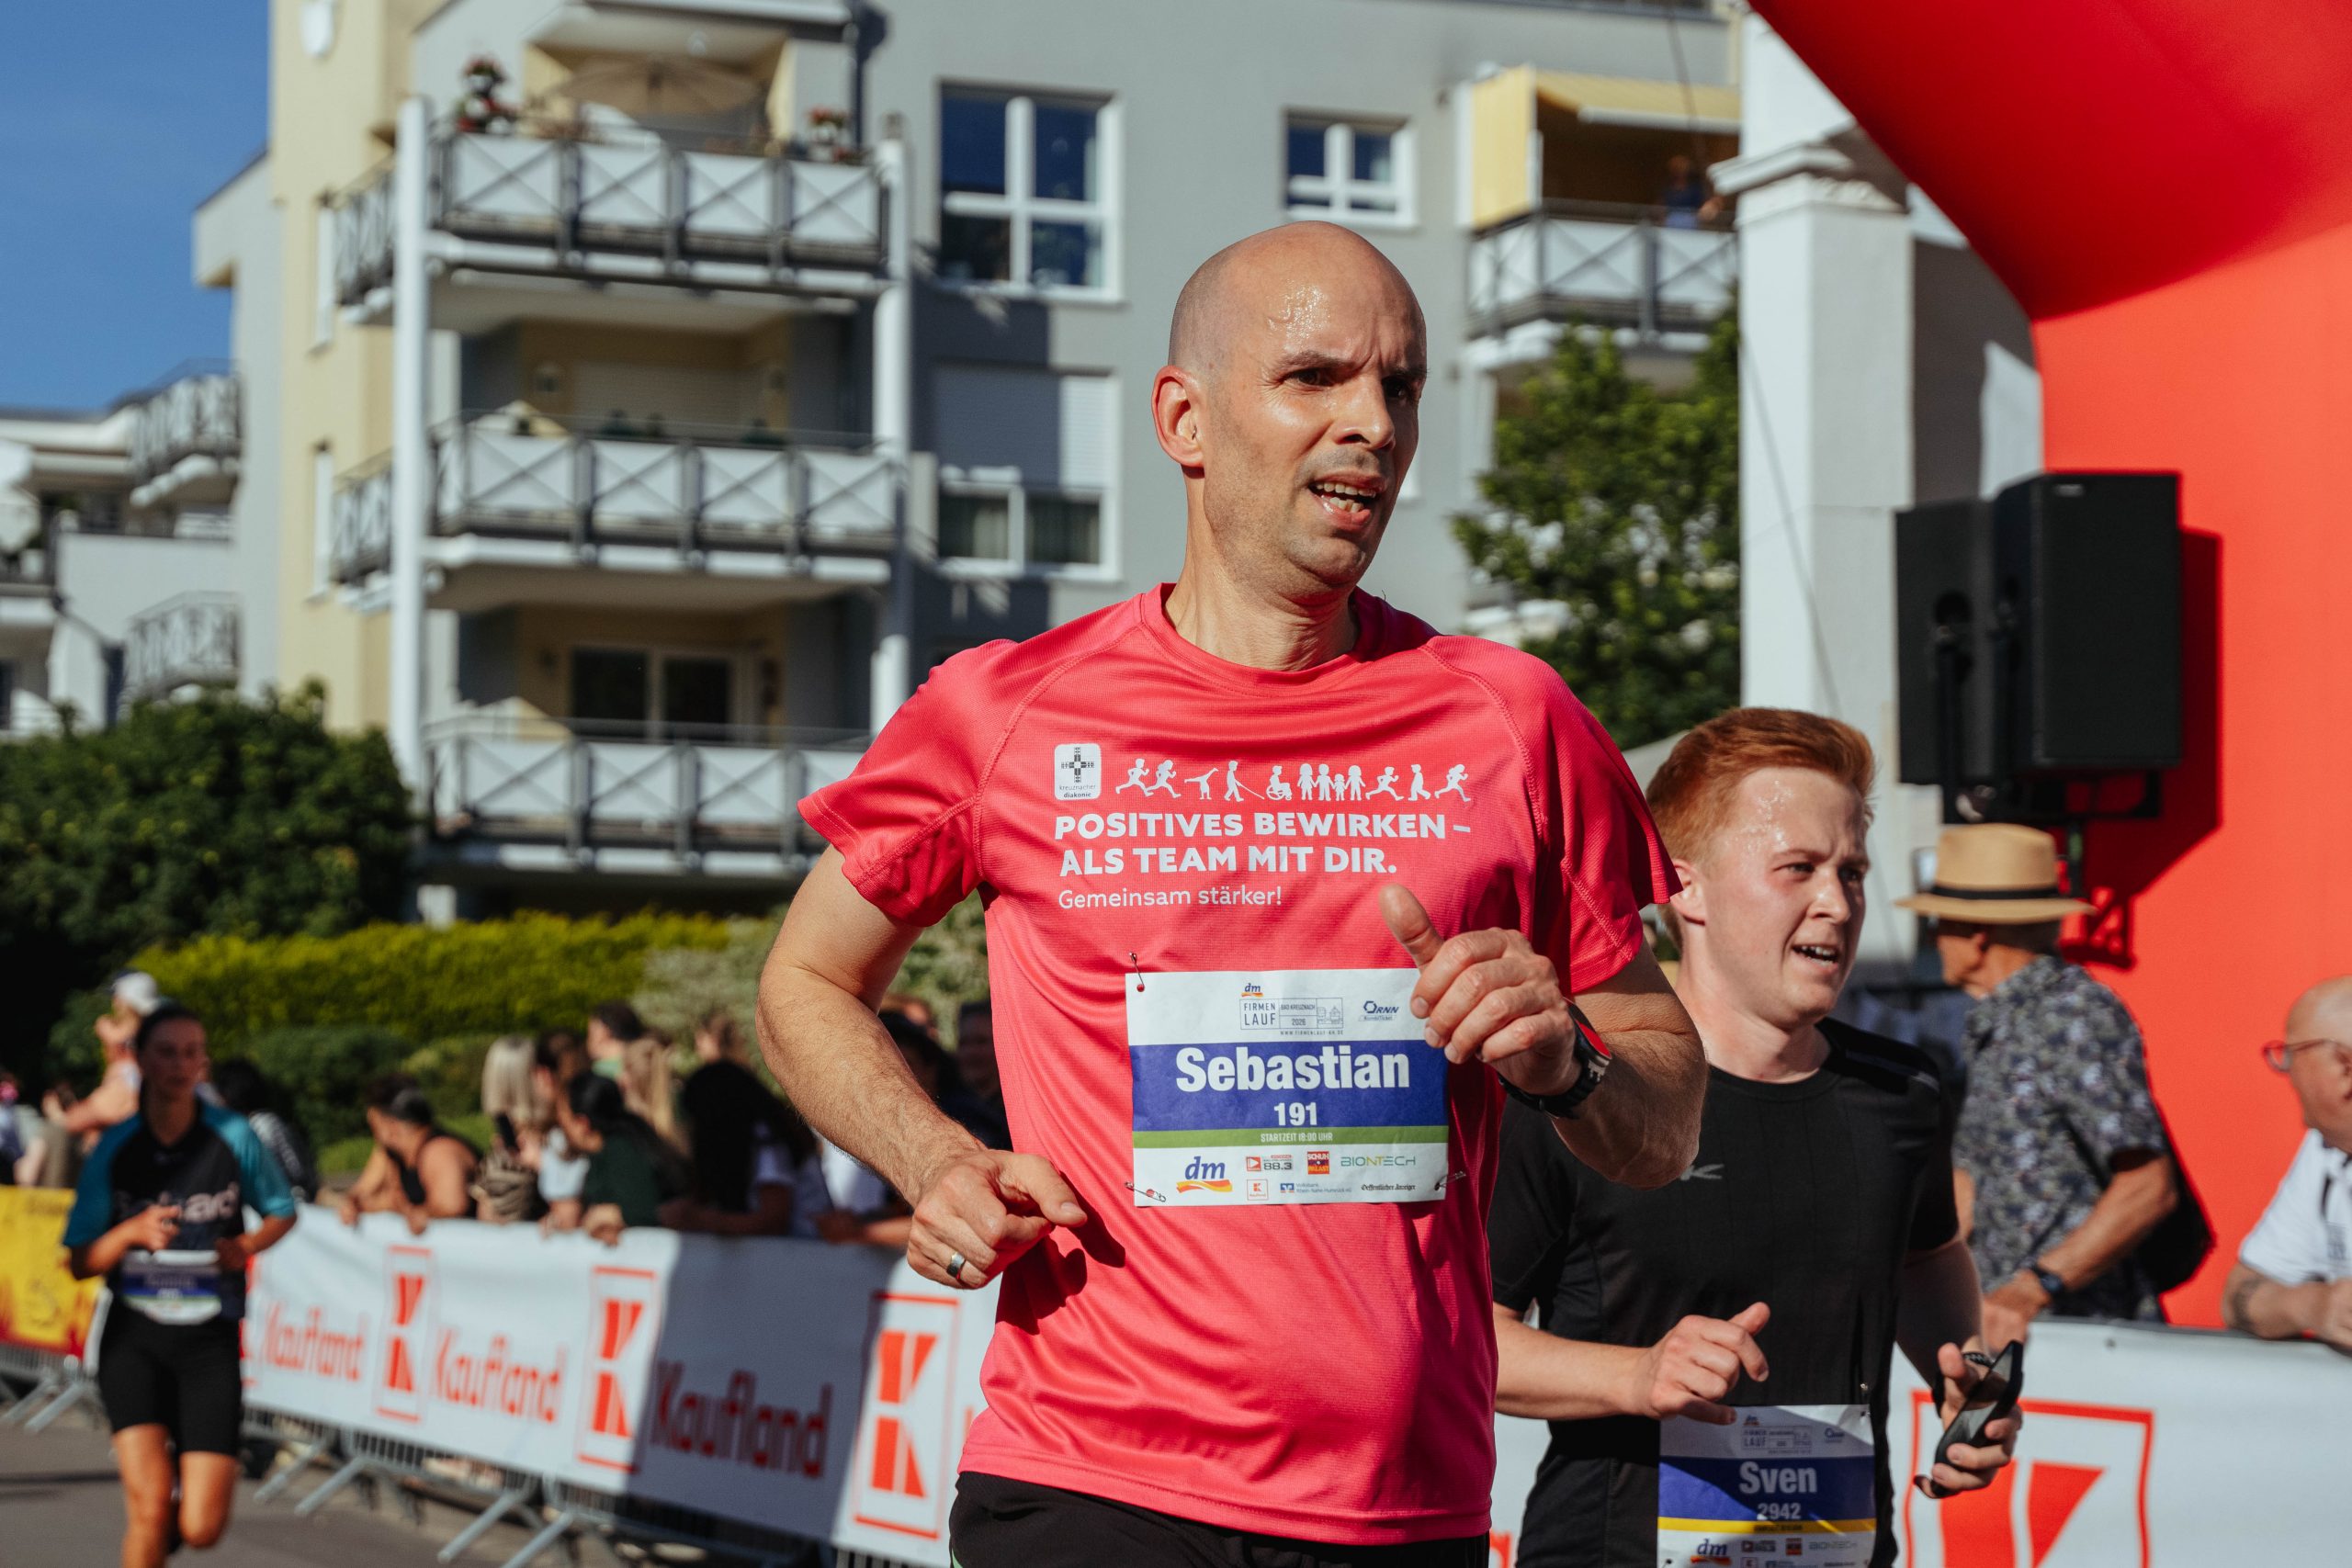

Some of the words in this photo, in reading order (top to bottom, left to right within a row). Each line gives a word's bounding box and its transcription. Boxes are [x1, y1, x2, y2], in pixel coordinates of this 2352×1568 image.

[1055, 812, 1244, 840] POSITIVES
[1254, 812, 1446, 840] BEWIRKEN
[1060, 847, 1125, 877] ALS
[1133, 846, 1237, 874] TEAM
[1248, 846, 1313, 874] MIT
[1324, 846, 1397, 874] DIR.
[1058, 888, 1193, 909] Gemeinsam
[1198, 886, 1282, 907] stärker!
[1244, 983, 1261, 993] dm
[1244, 1002, 1275, 1010] FIRMEN
[1244, 1012, 1275, 1026] LAUF
[1176, 1045, 1409, 1092] Sebastian
[1274, 1102, 1317, 1126] 191
[1261, 1133, 1296, 1143] STARTZEIT
[1318, 1132, 1333, 1141] UHR
[1184, 1156, 1226, 1180] dm
[1263, 1162, 1292, 1170] 88.3
[1340, 1156, 1416, 1167] BIONTECH
[433, 1328, 568, 1424] Kaufland
[648, 1359, 832, 1480] Kaufland
[1739, 1461, 1817, 1494] Sven
[1757, 1502, 1801, 1520] 2942
[1696, 1538, 1728, 1556] dm
